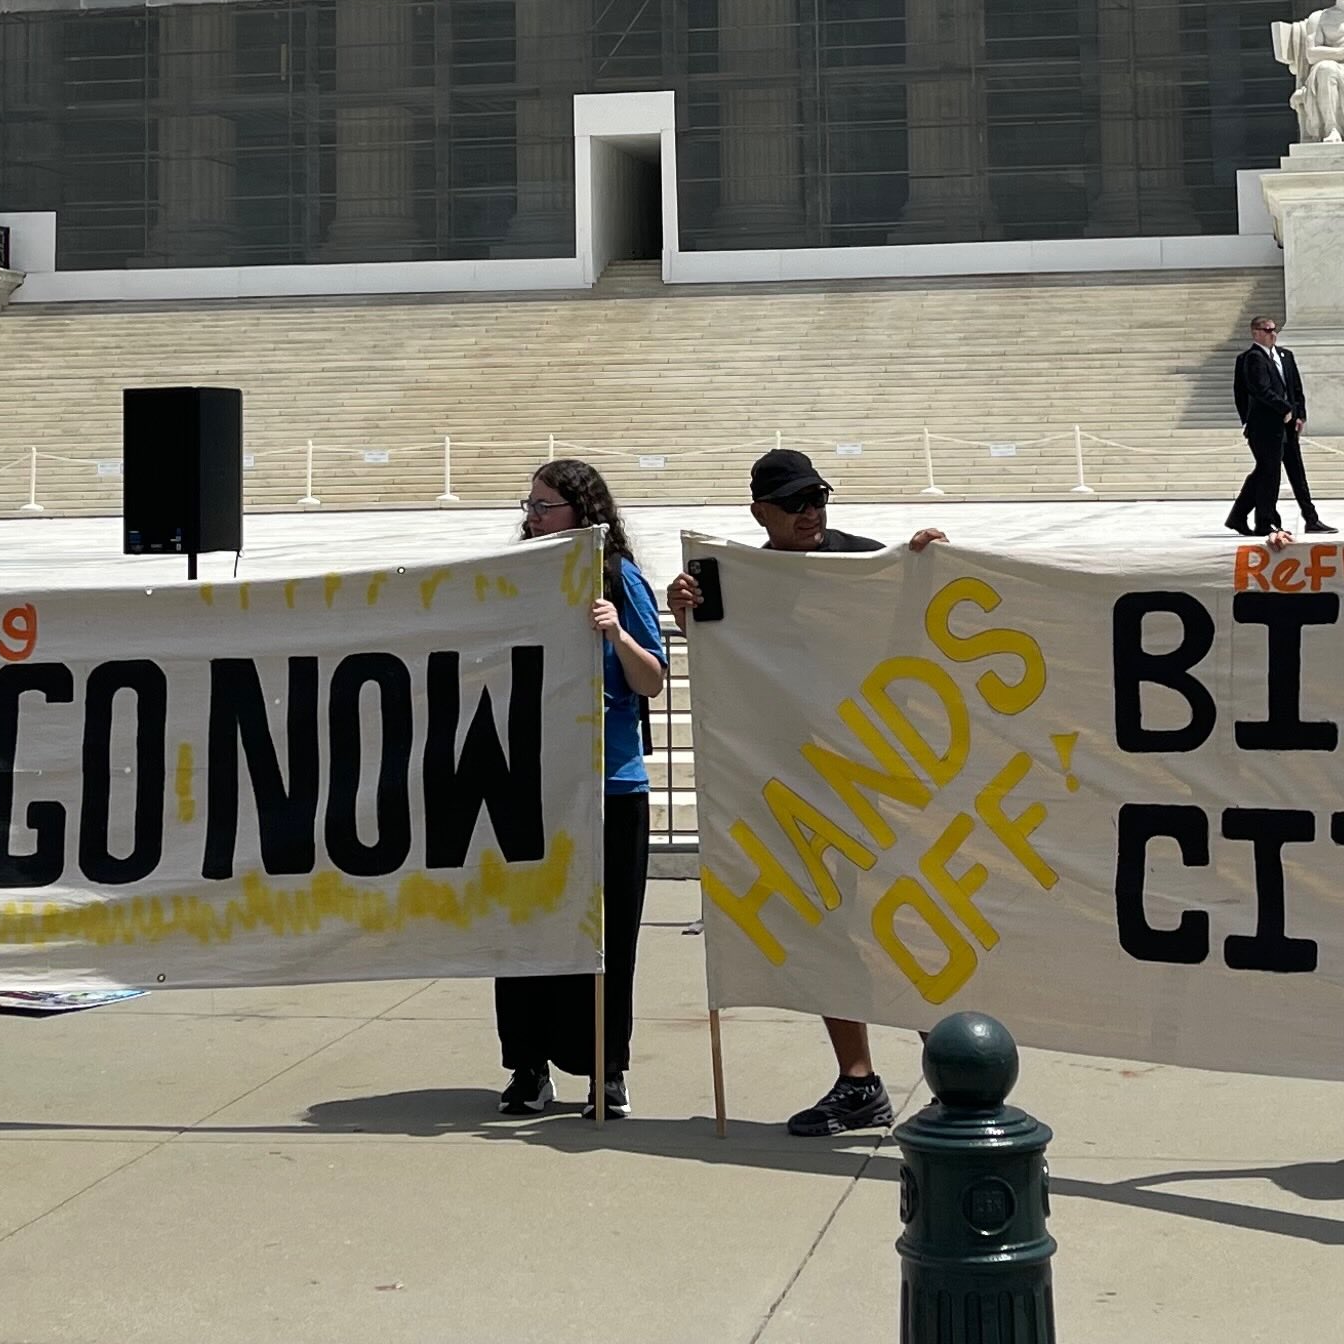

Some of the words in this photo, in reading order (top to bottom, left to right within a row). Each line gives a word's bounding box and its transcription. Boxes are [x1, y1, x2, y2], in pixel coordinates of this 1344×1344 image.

[201, 644, 545, 881] NOW
[700, 577, 1047, 967] HANDS
[871, 732, 1079, 1004] OFF!
